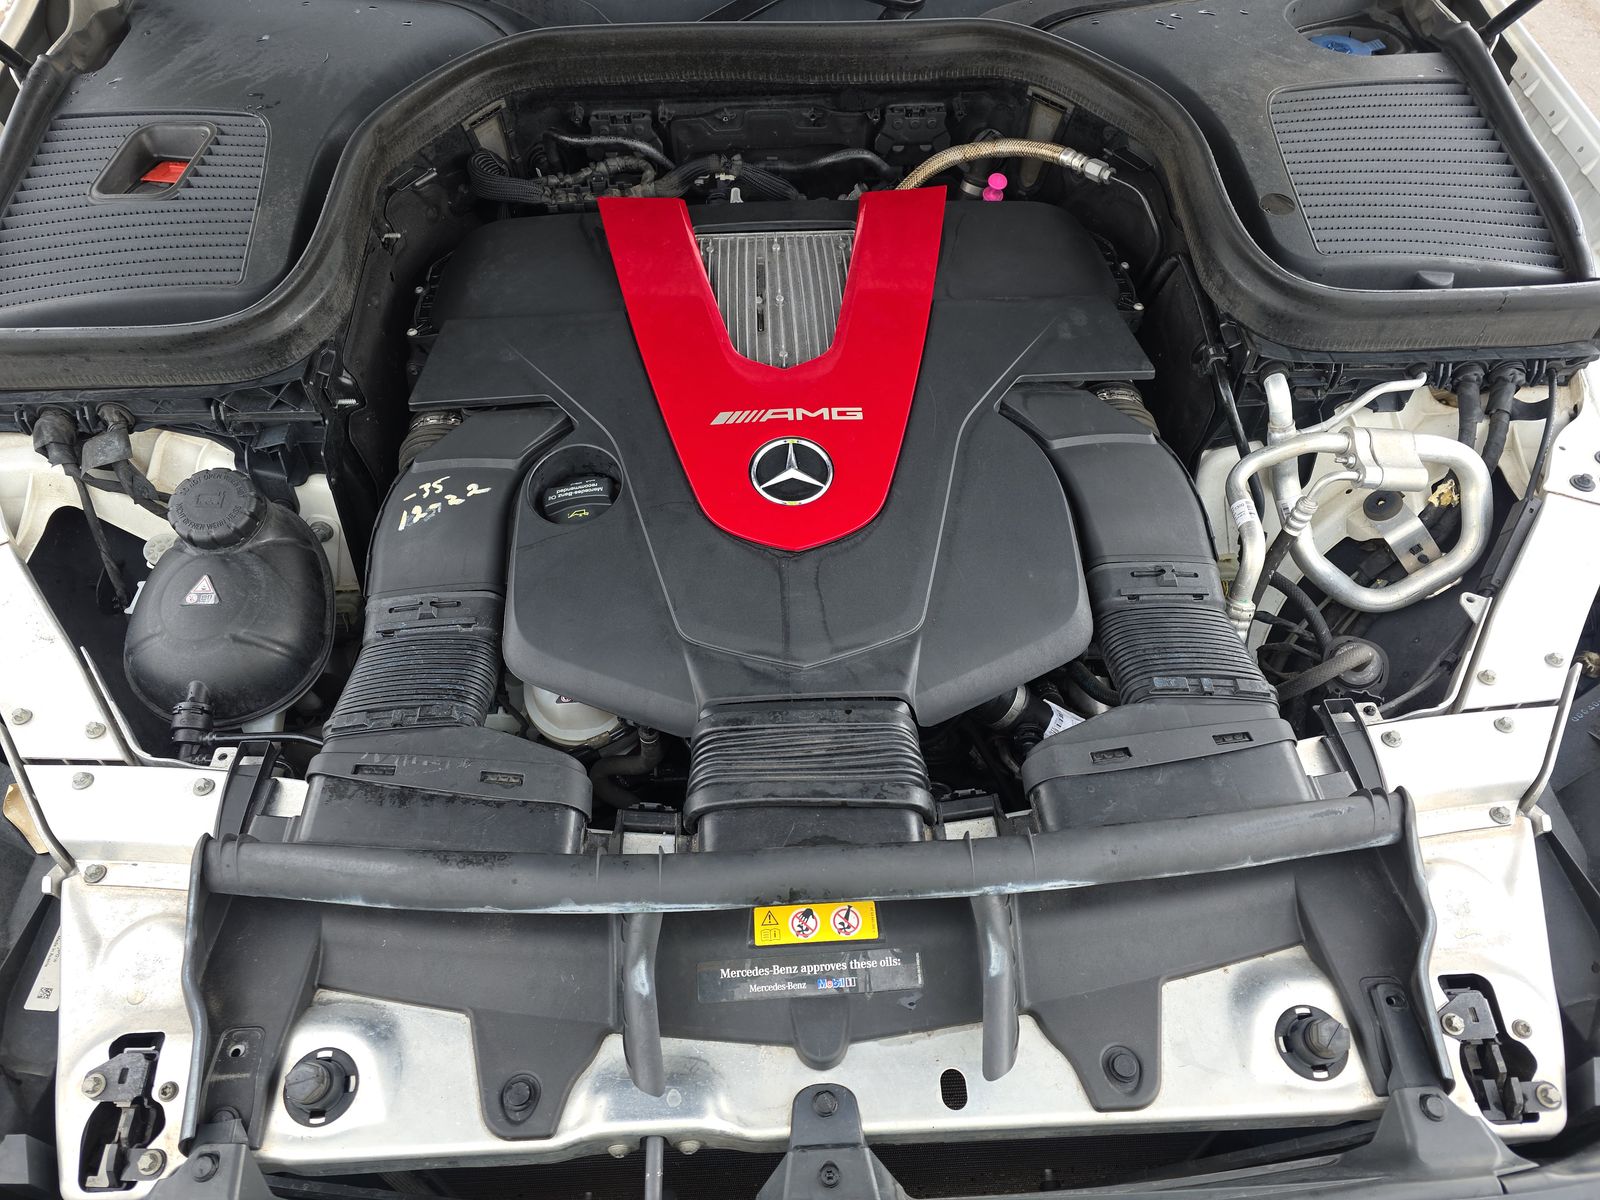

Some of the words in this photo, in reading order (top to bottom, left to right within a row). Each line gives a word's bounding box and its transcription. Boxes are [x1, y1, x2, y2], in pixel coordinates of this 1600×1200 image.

[759, 407, 864, 422] AMG
[556, 482, 598, 494] recommended
[720, 963, 799, 979] Mercedes-Benz
[800, 961, 848, 975] approves
[849, 959, 878, 970] these
[879, 956, 902, 967] oils:
[748, 980, 807, 994] Mercedes-Benz
[817, 977, 845, 990] Mobil
